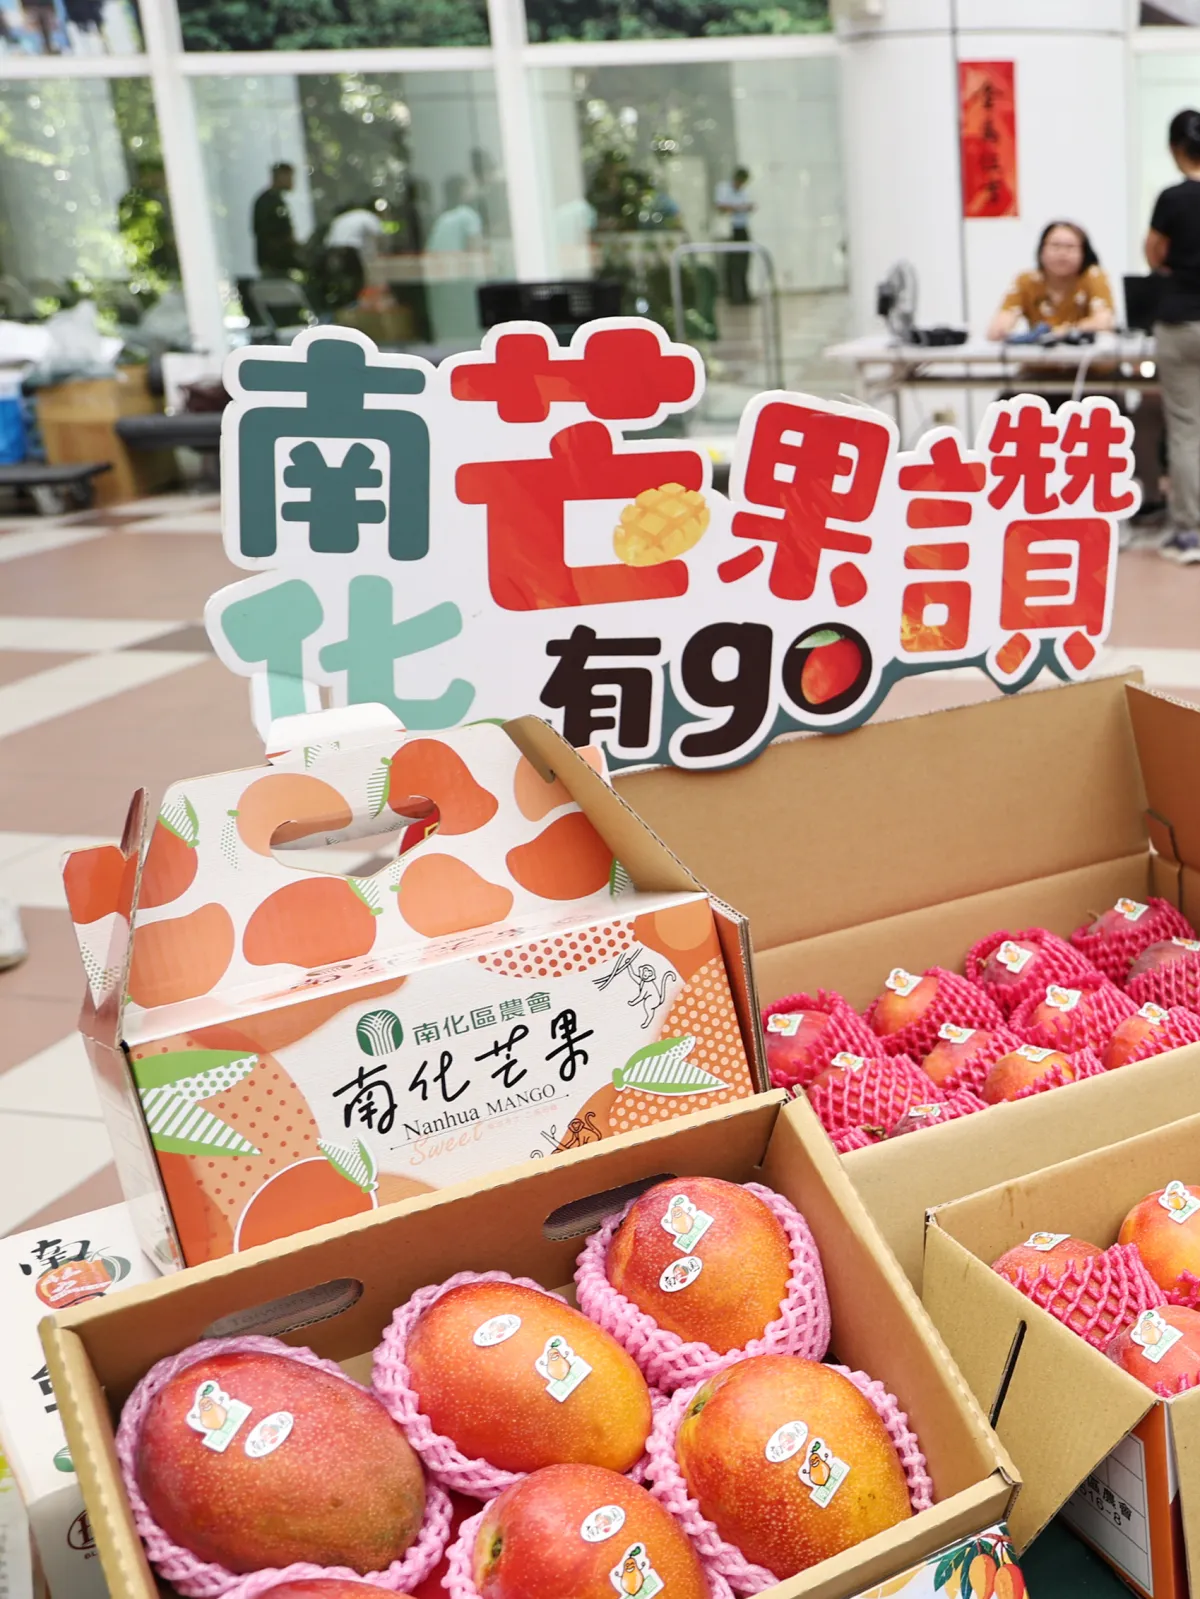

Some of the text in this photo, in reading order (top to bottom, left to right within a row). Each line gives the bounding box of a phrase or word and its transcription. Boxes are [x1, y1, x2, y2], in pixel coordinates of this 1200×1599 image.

[412, 991, 552, 1046] 南化區農會
[332, 1008, 594, 1135] 南化芒果
[402, 1105, 481, 1140] Nanhua
[486, 1083, 557, 1117] MANGO
[409, 1121, 485, 1167] Sweet
